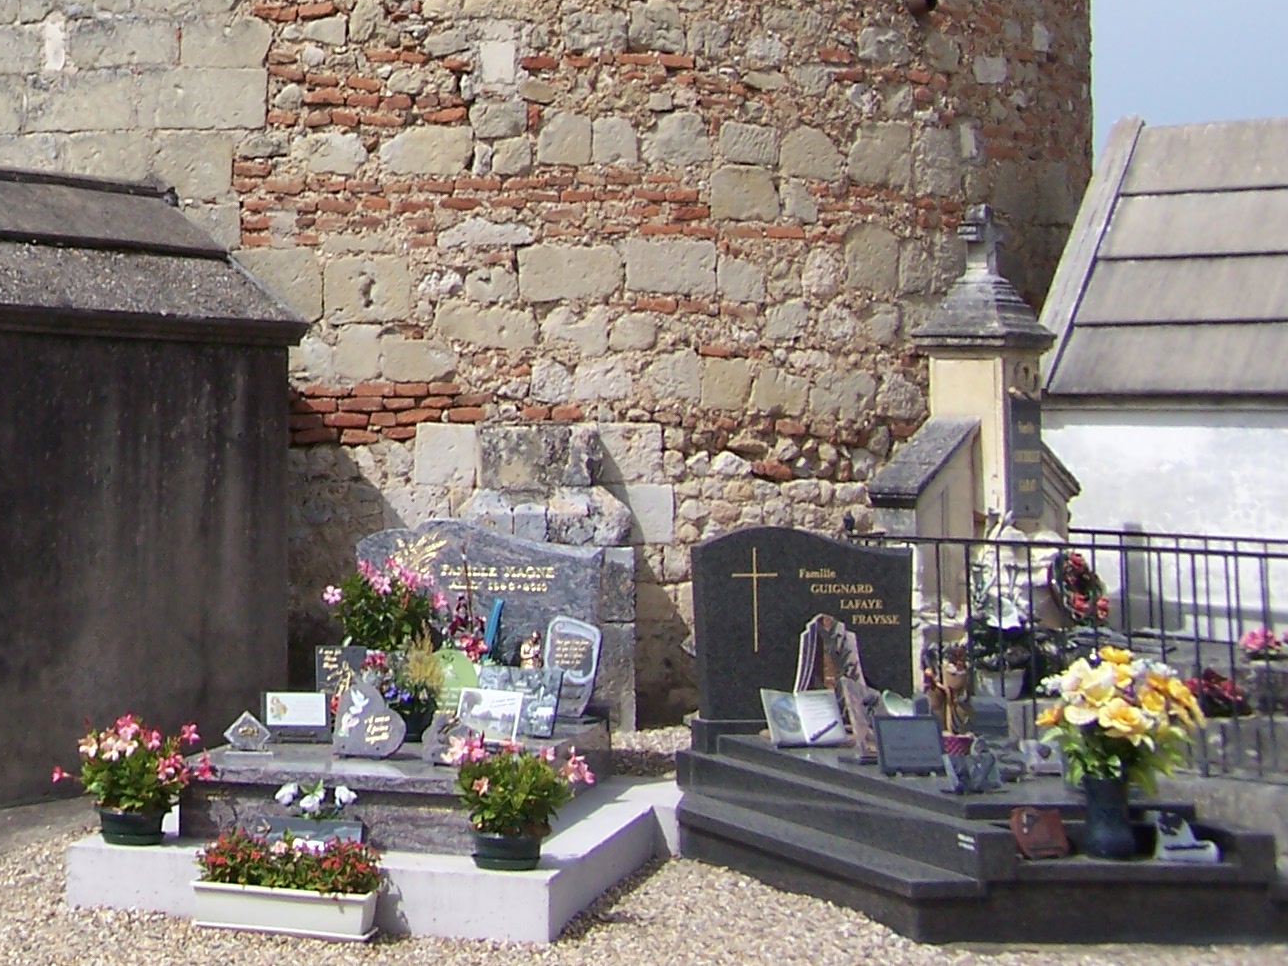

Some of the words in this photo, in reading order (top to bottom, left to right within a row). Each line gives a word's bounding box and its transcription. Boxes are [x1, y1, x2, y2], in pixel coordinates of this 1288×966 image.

[503, 565, 556, 579] MAGNE
[798, 567, 837, 579] Famille
[810, 583, 874, 594] GUIGNARD
[839, 598, 884, 610] LAFAYE
[851, 613, 900, 625] FRAYSSE
